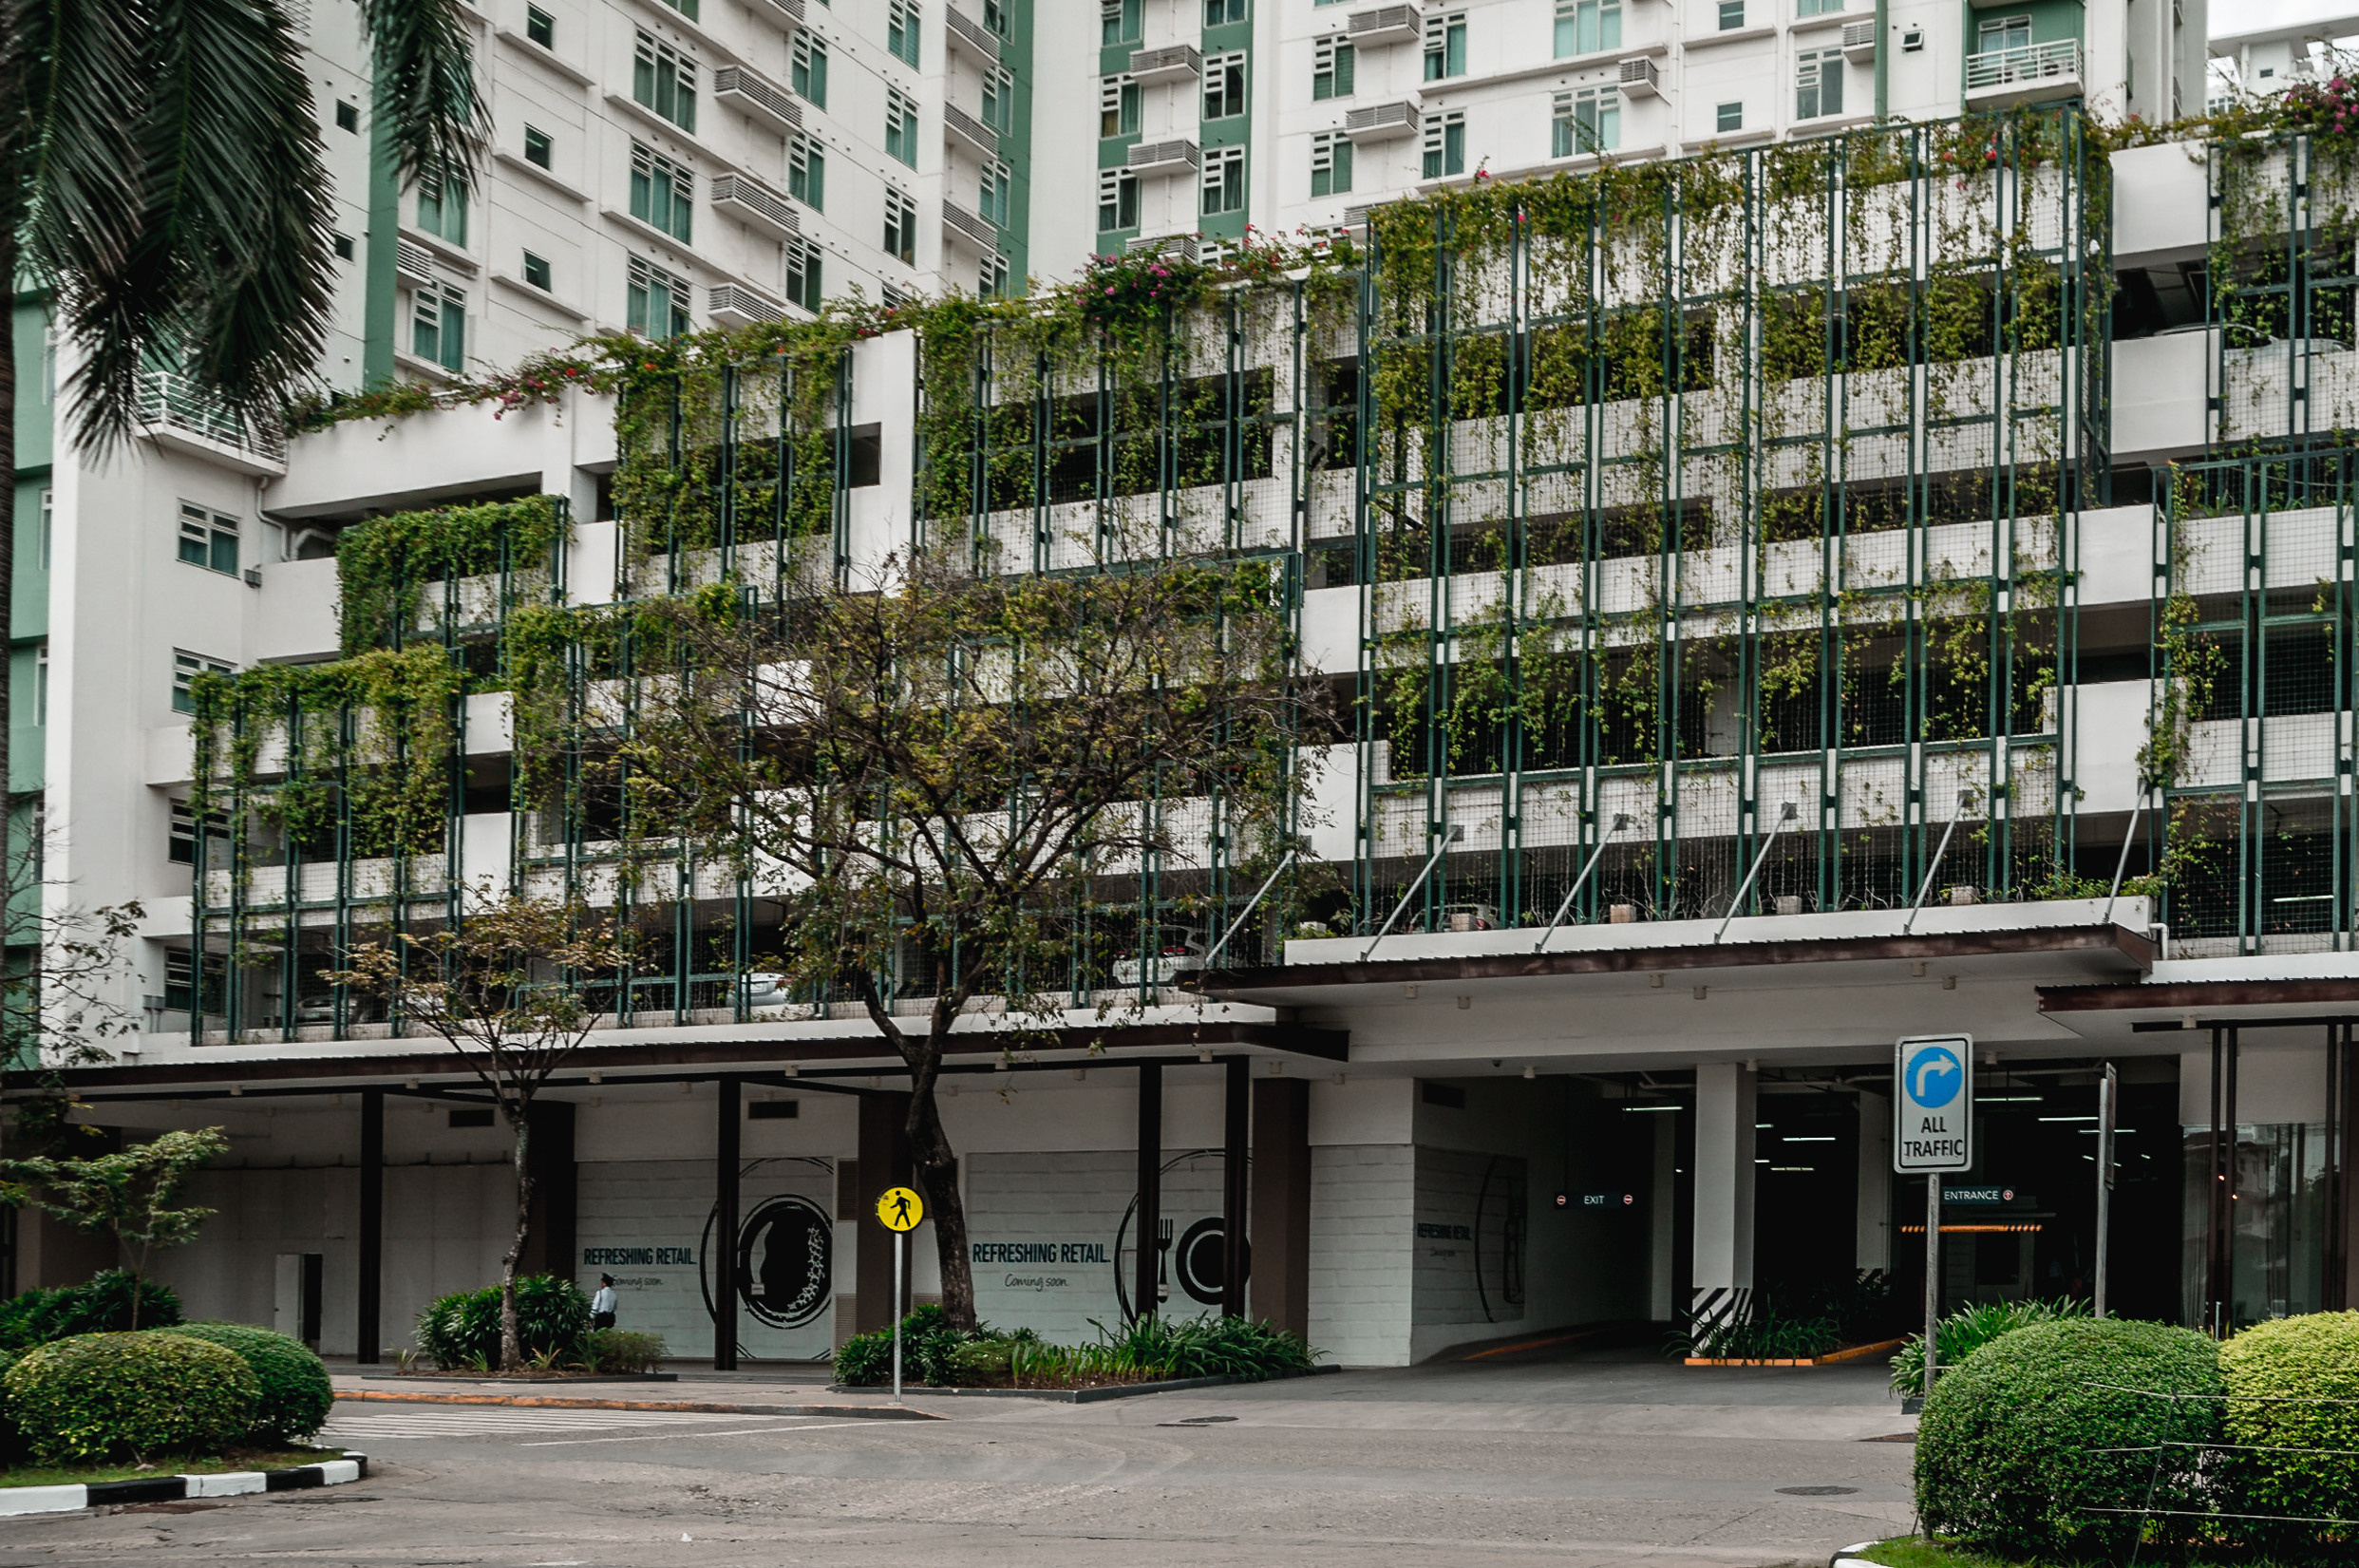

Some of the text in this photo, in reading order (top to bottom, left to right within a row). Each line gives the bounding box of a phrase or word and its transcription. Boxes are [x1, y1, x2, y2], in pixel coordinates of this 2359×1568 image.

[1920, 1116, 1947, 1133] ALL
[1903, 1139, 1963, 1157] TRAFFIC
[1584, 1195, 1605, 1204] EXIT
[1943, 1190, 1999, 1200] ENTRANCE
[584, 1247, 653, 1265] REFRESHING
[972, 1243, 1111, 1263] REFRESHING RETAIL.
[1005, 1274, 1068, 1292] Coming soon
